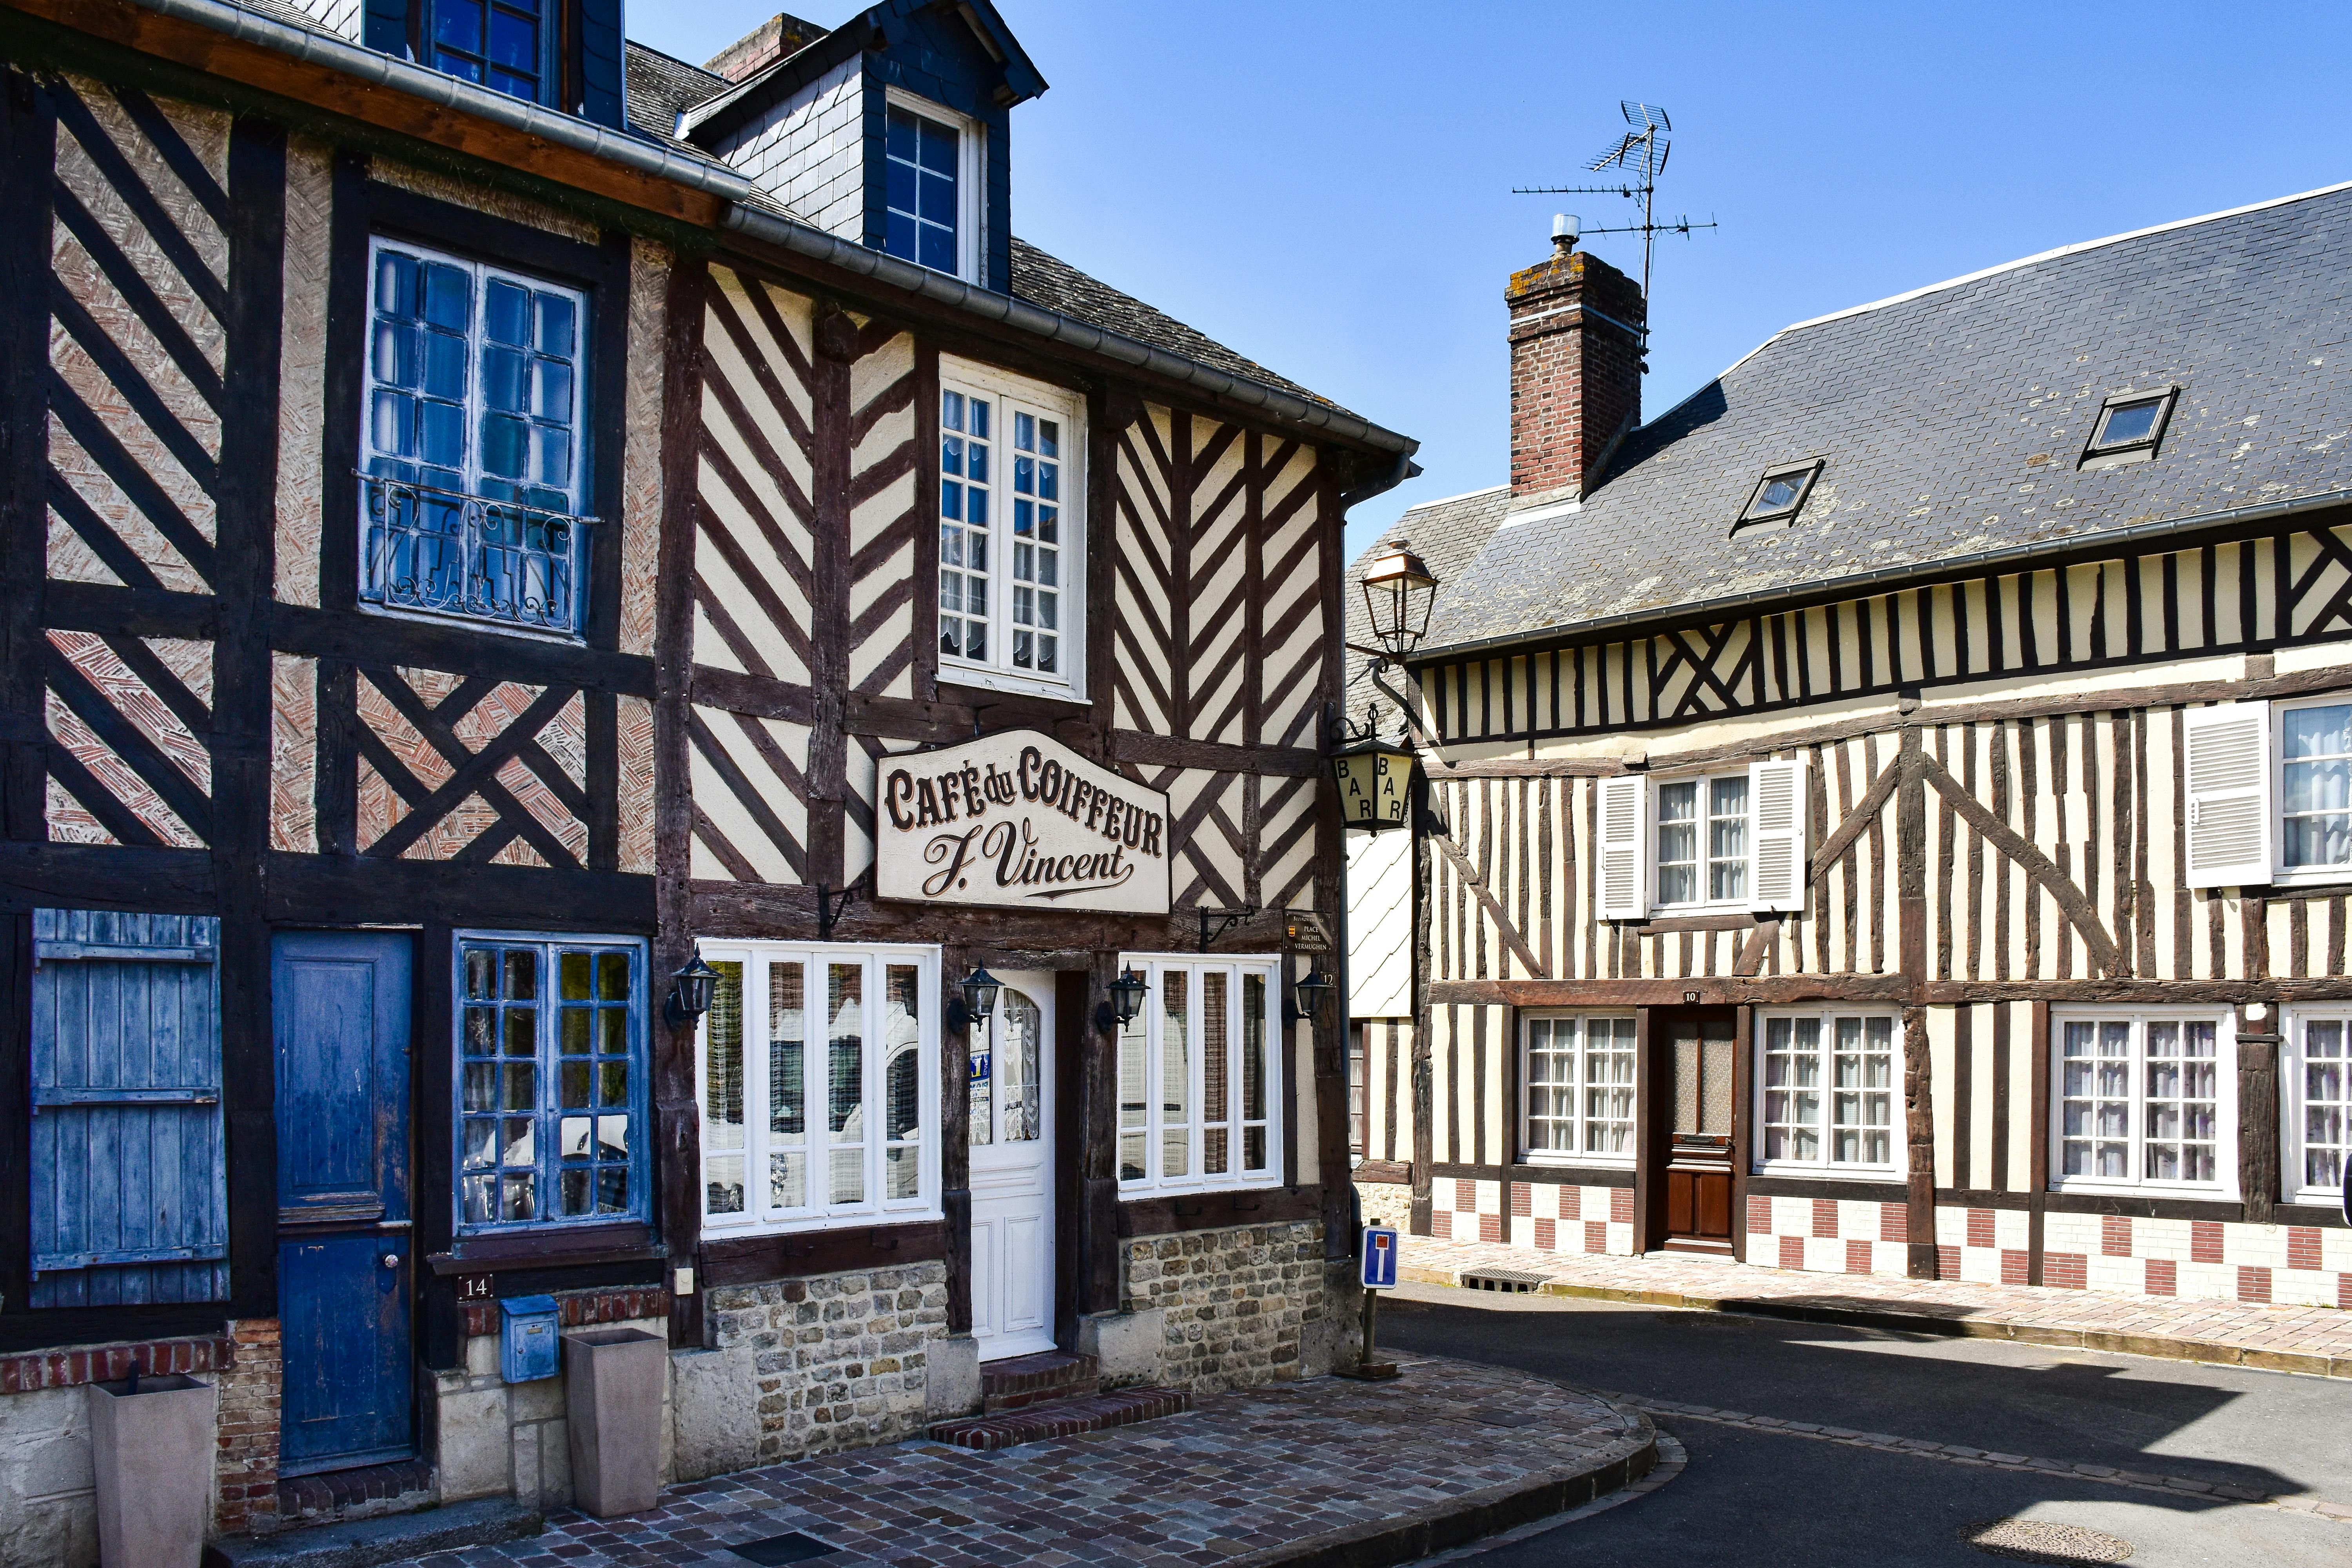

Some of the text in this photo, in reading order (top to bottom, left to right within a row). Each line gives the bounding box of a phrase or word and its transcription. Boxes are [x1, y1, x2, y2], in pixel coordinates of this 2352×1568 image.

[885, 746, 1163, 858] CAFÉ du COIFFEUR
[1337, 760, 1372, 818] BAR
[1378, 757, 1401, 819] BAR
[982, 817, 1134, 901] Vincent
[1323, 974, 1333, 985] 12
[1686, 993, 1695, 1001] 10
[466, 1278, 487, 1296] 14
